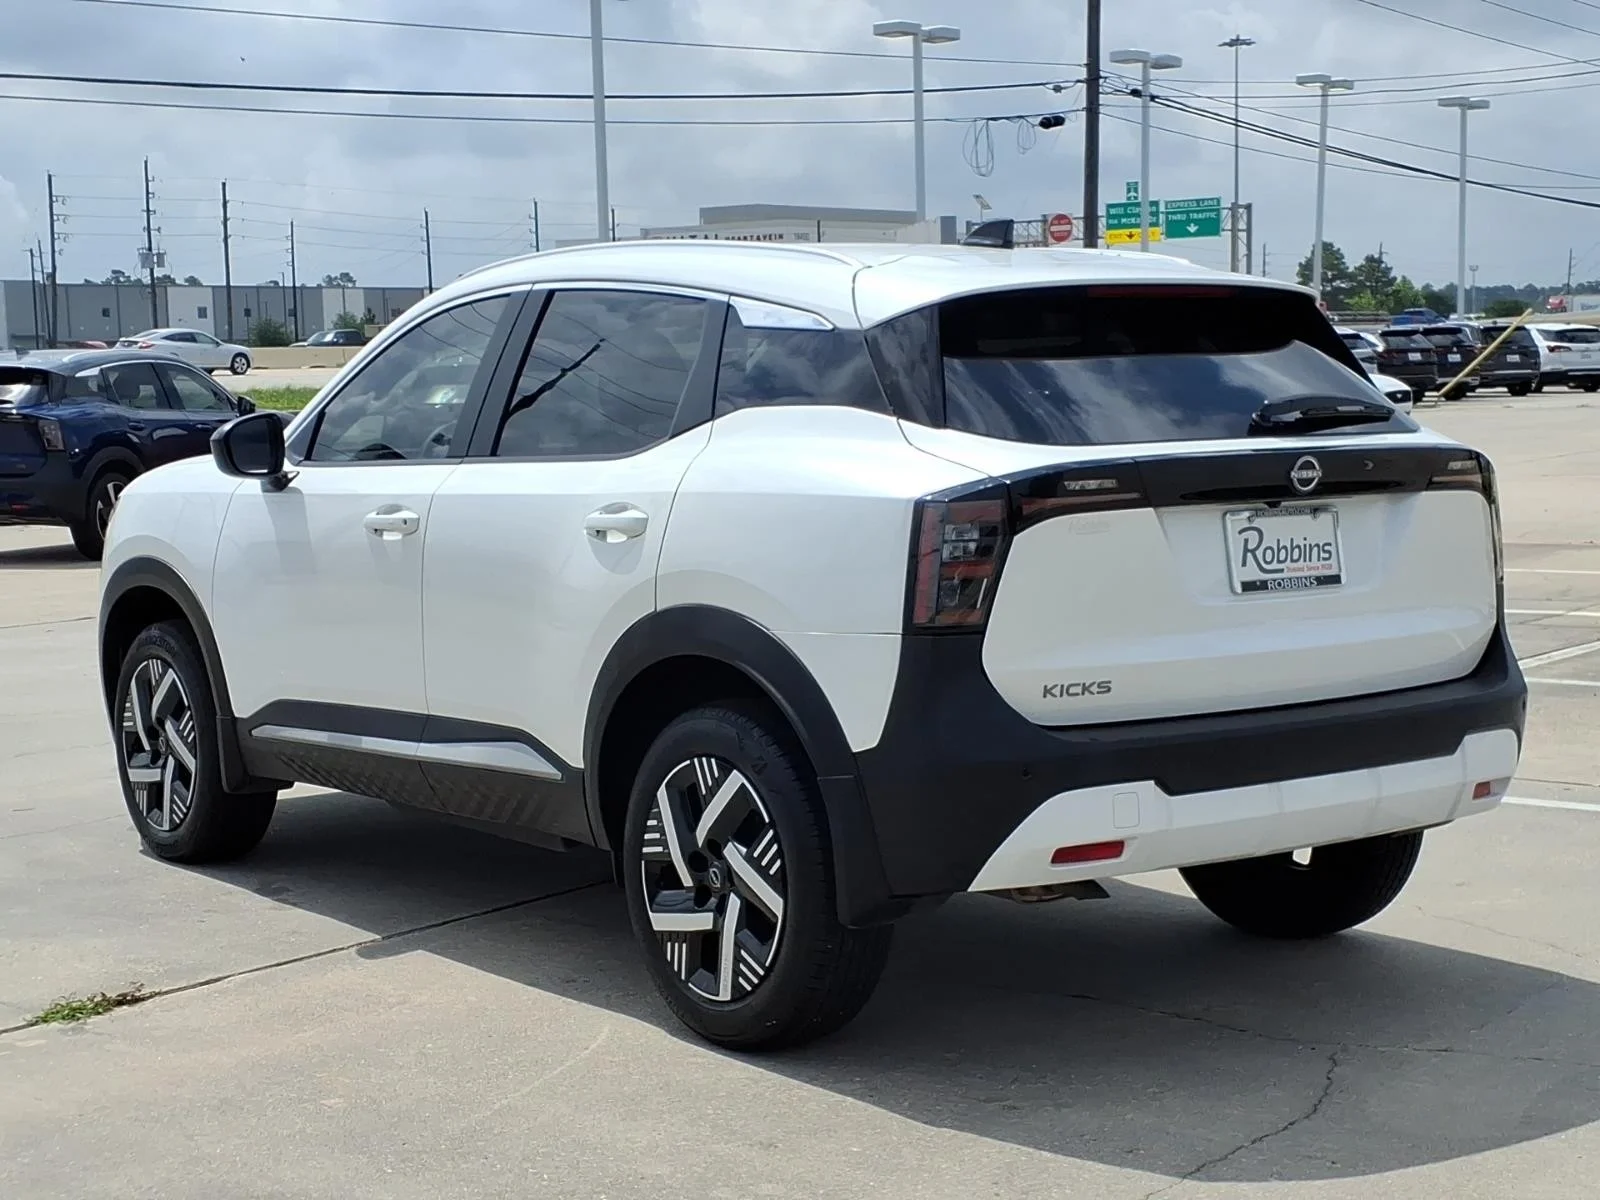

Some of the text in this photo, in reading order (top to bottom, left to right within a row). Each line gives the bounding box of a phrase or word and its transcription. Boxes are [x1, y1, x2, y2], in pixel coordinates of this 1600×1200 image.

[1238, 526, 1332, 574] Robbins
[1267, 577, 1317, 590] ROBBINS
[1042, 680, 1112, 698] KICKS
